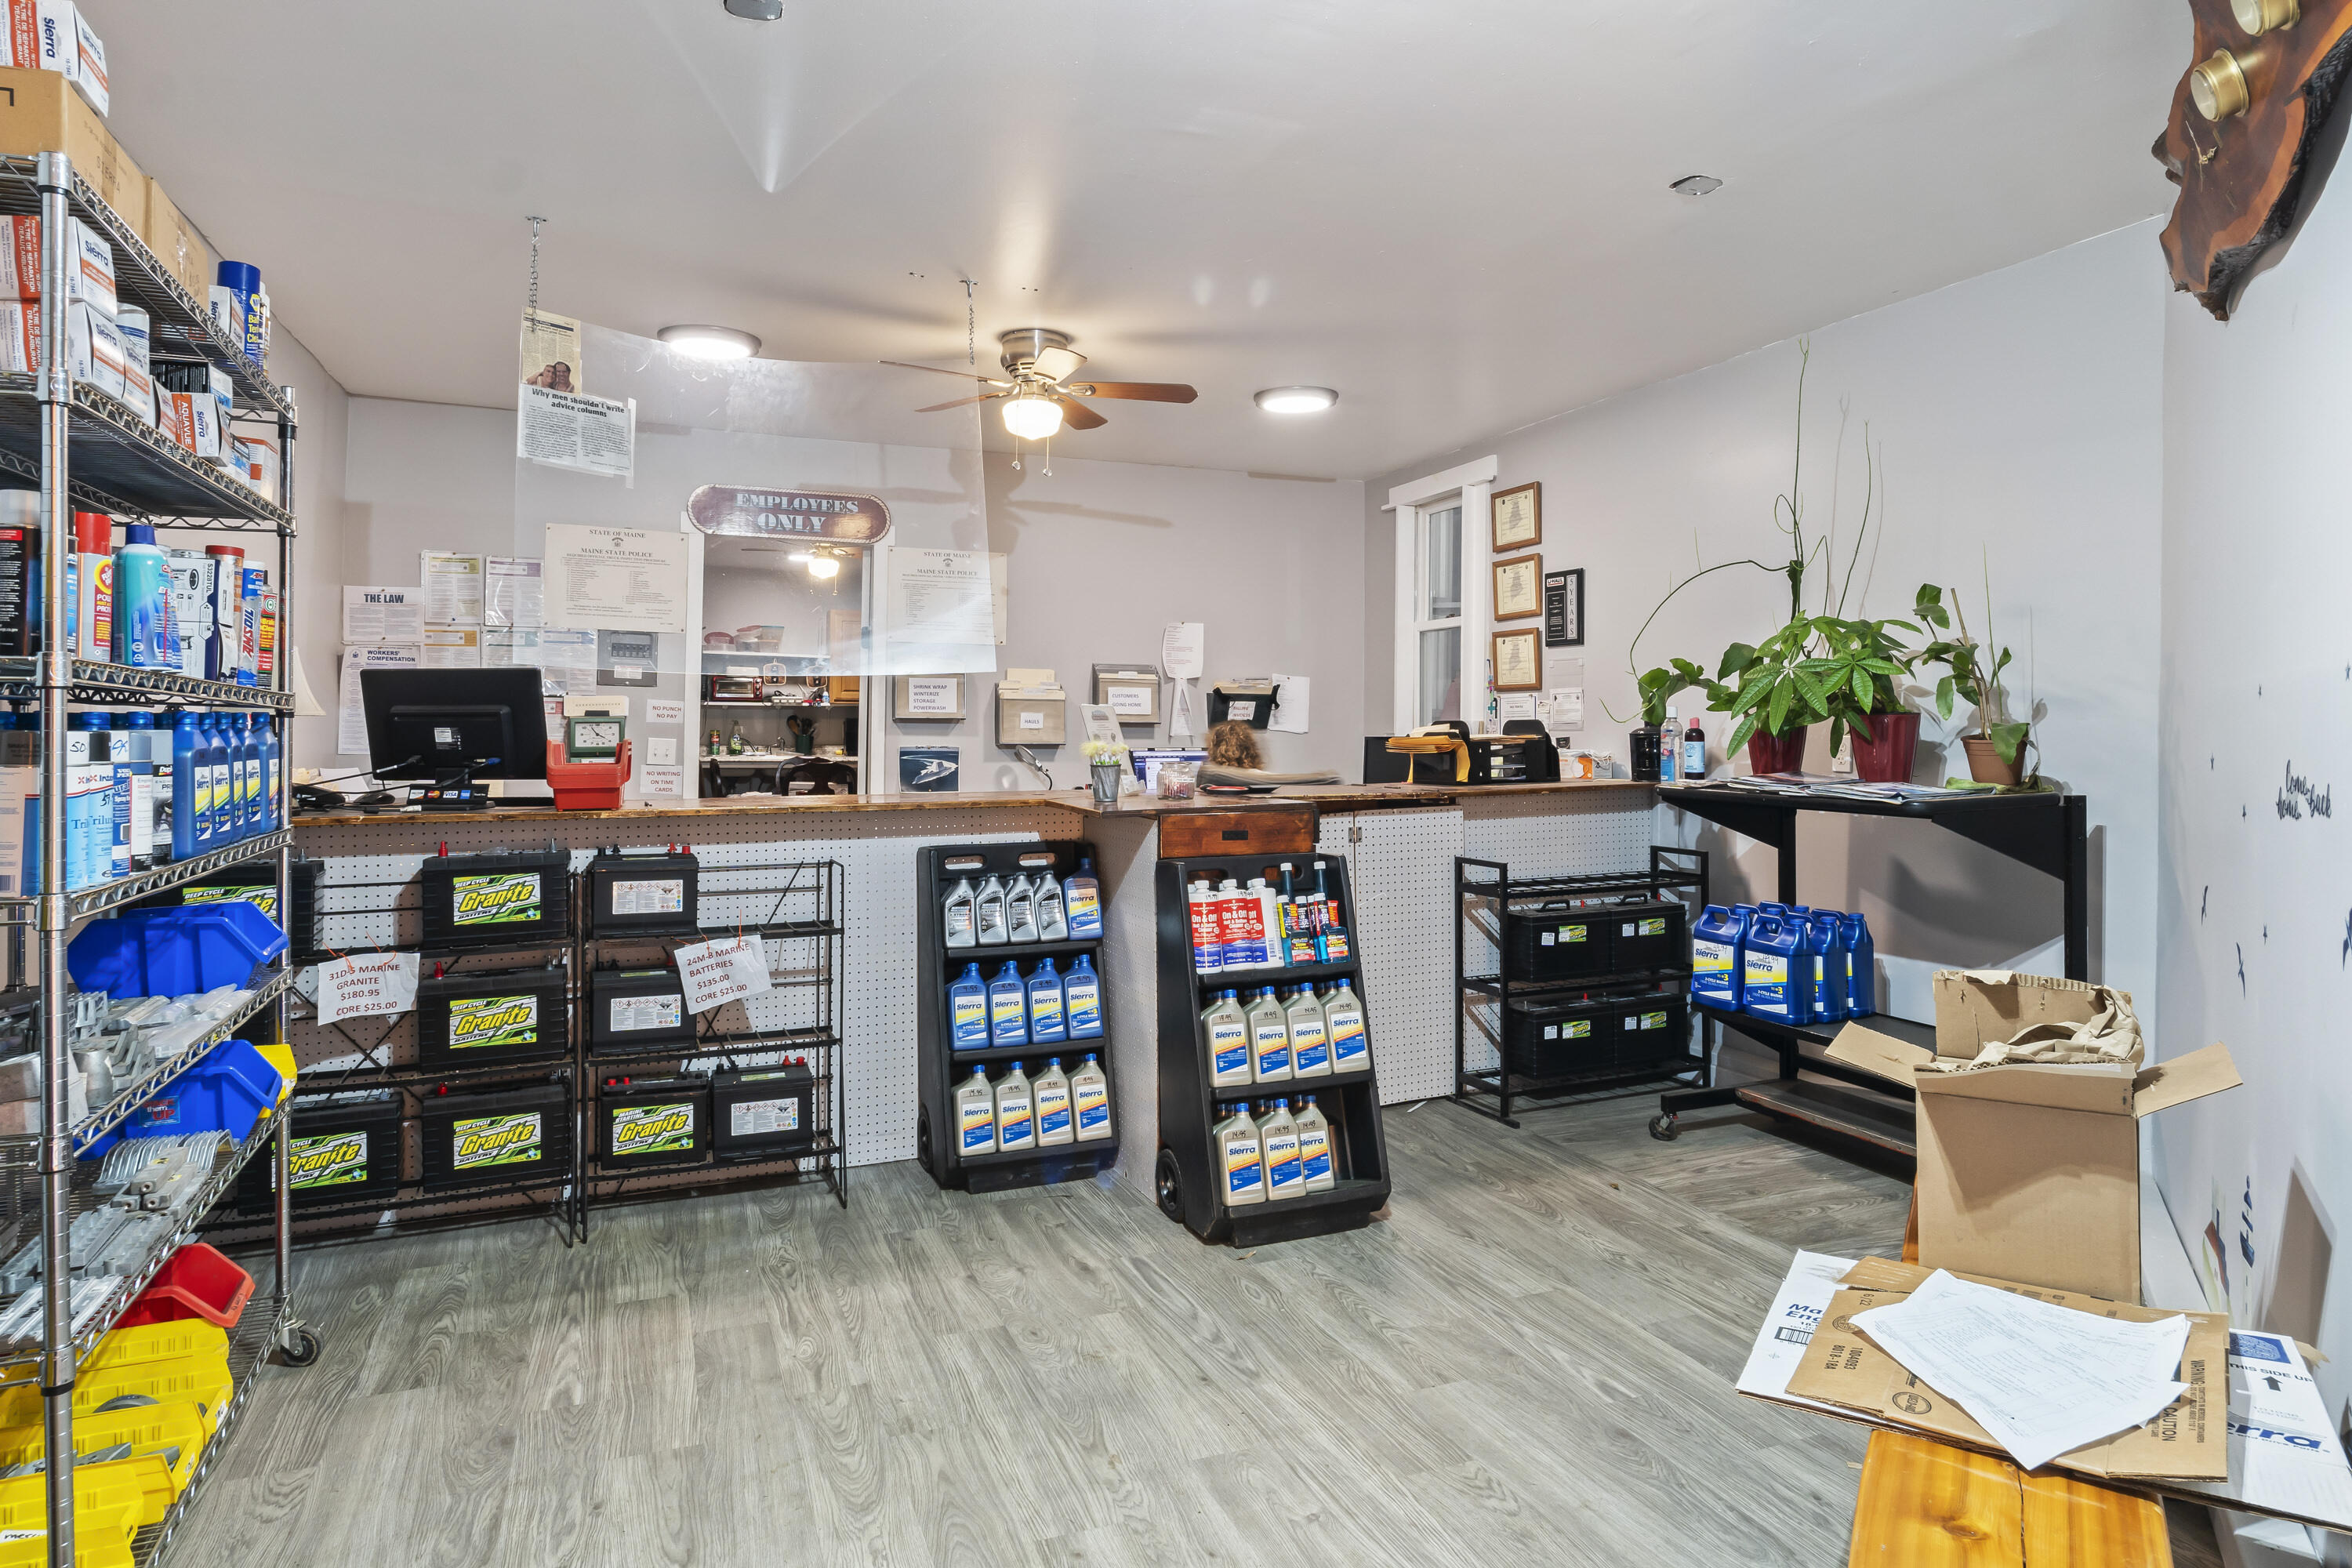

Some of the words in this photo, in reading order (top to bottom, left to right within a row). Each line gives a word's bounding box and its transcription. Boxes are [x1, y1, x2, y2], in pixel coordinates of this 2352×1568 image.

[44, 16, 56, 59] Sierra
[85, 240, 109, 267] Sierra
[96, 324, 117, 347] Sierra
[532, 387, 550, 399] Why
[552, 393, 568, 401] men
[570, 396, 604, 408] shouldn't
[551, 401, 575, 412] advice
[577, 407, 608, 418] columns
[182, 401, 192, 445] AQUAVUE
[197, 411, 205, 438] Sierra
[735, 492, 859, 514] EMPLOYEES
[757, 513, 827, 532] ONLY
[364, 593, 382, 603] THE
[383, 594, 405, 604] LAW
[242, 607, 254, 661] AMSOIL
[197, 779, 209, 789] Sierra
[215, 777, 228, 787] Sierra
[2285, 759, 2310, 795] Come
[2275, 786, 2302, 821] home
[459, 884, 535, 913] Granite
[716, 943, 750, 957] MARINE
[1695, 948, 1719, 960] Sierra
[359, 964, 401, 973] MARINE
[690, 960, 733, 978] BATTERIES
[1747, 960, 1773, 971] Sierra
[336, 977, 379, 990] GRANITE
[697, 974, 729, 989] $135.00
[341, 989, 380, 1001] $180.95
[695, 992, 718, 1004] CORE
[720, 985, 747, 996] $25.00
[336, 1005, 361, 1016] CORE
[364, 1001, 397, 1012] $25.00
[454, 1005, 532, 1036] Granite
[1334, 1018, 1359, 1027] Sierra
[1215, 1030, 1242, 1039] Sierra
[1258, 1032, 1283, 1040] Sierra
[1295, 1029, 1321, 1037] Sierra
[1040, 1094, 1065, 1103] Sierra
[1079, 1090, 1103, 1098] Sierra
[153, 1109, 175, 1120] UP
[615, 1112, 644, 1123] STARTING
[619, 1109, 643, 1117] MARINE
[470, 1119, 491, 1127] CYCLE
[618, 1114, 688, 1142] Granite
[291, 1138, 312, 1148] CYCLE
[459, 1124, 535, 1157] Granite
[1269, 1142, 1295, 1151] Sierra
[1229, 1146, 1256, 1156] Sierra
[1860, 1294, 1875, 1306] 6/22
[1824, 1345, 1846, 1370] 8018-18A
[1844, 1347, 1863, 1370] 1004093
[2190, 1359, 2205, 1386] WARNING:
[2262, 1368, 2291, 1379] SIDE
[2161, 1407, 2178, 1442] CAUTION
